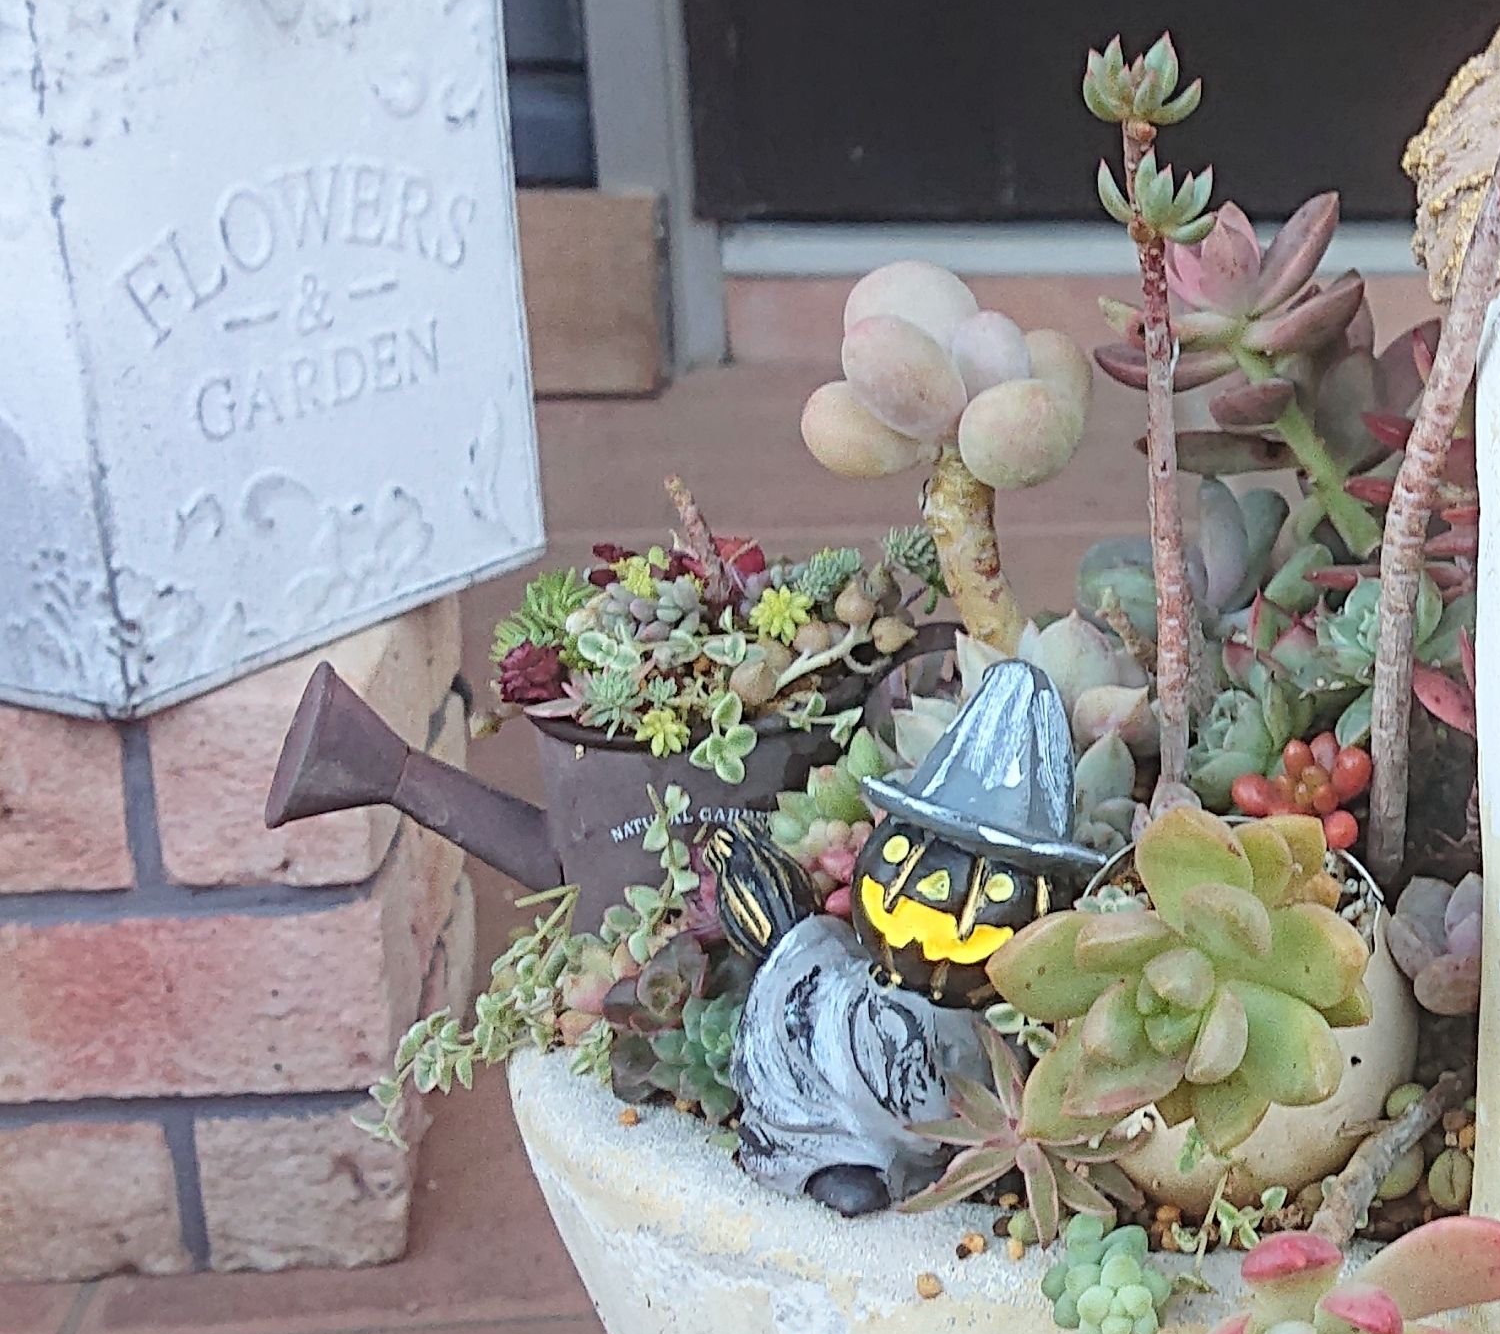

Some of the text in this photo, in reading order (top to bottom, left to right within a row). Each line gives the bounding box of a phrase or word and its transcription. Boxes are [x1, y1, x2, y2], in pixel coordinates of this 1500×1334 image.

[120, 159, 476, 349] FLOWERS
[296, 274, 335, 336] &
[195, 317, 441, 443] GARDEN
[610, 805, 694, 843] NATUAL
